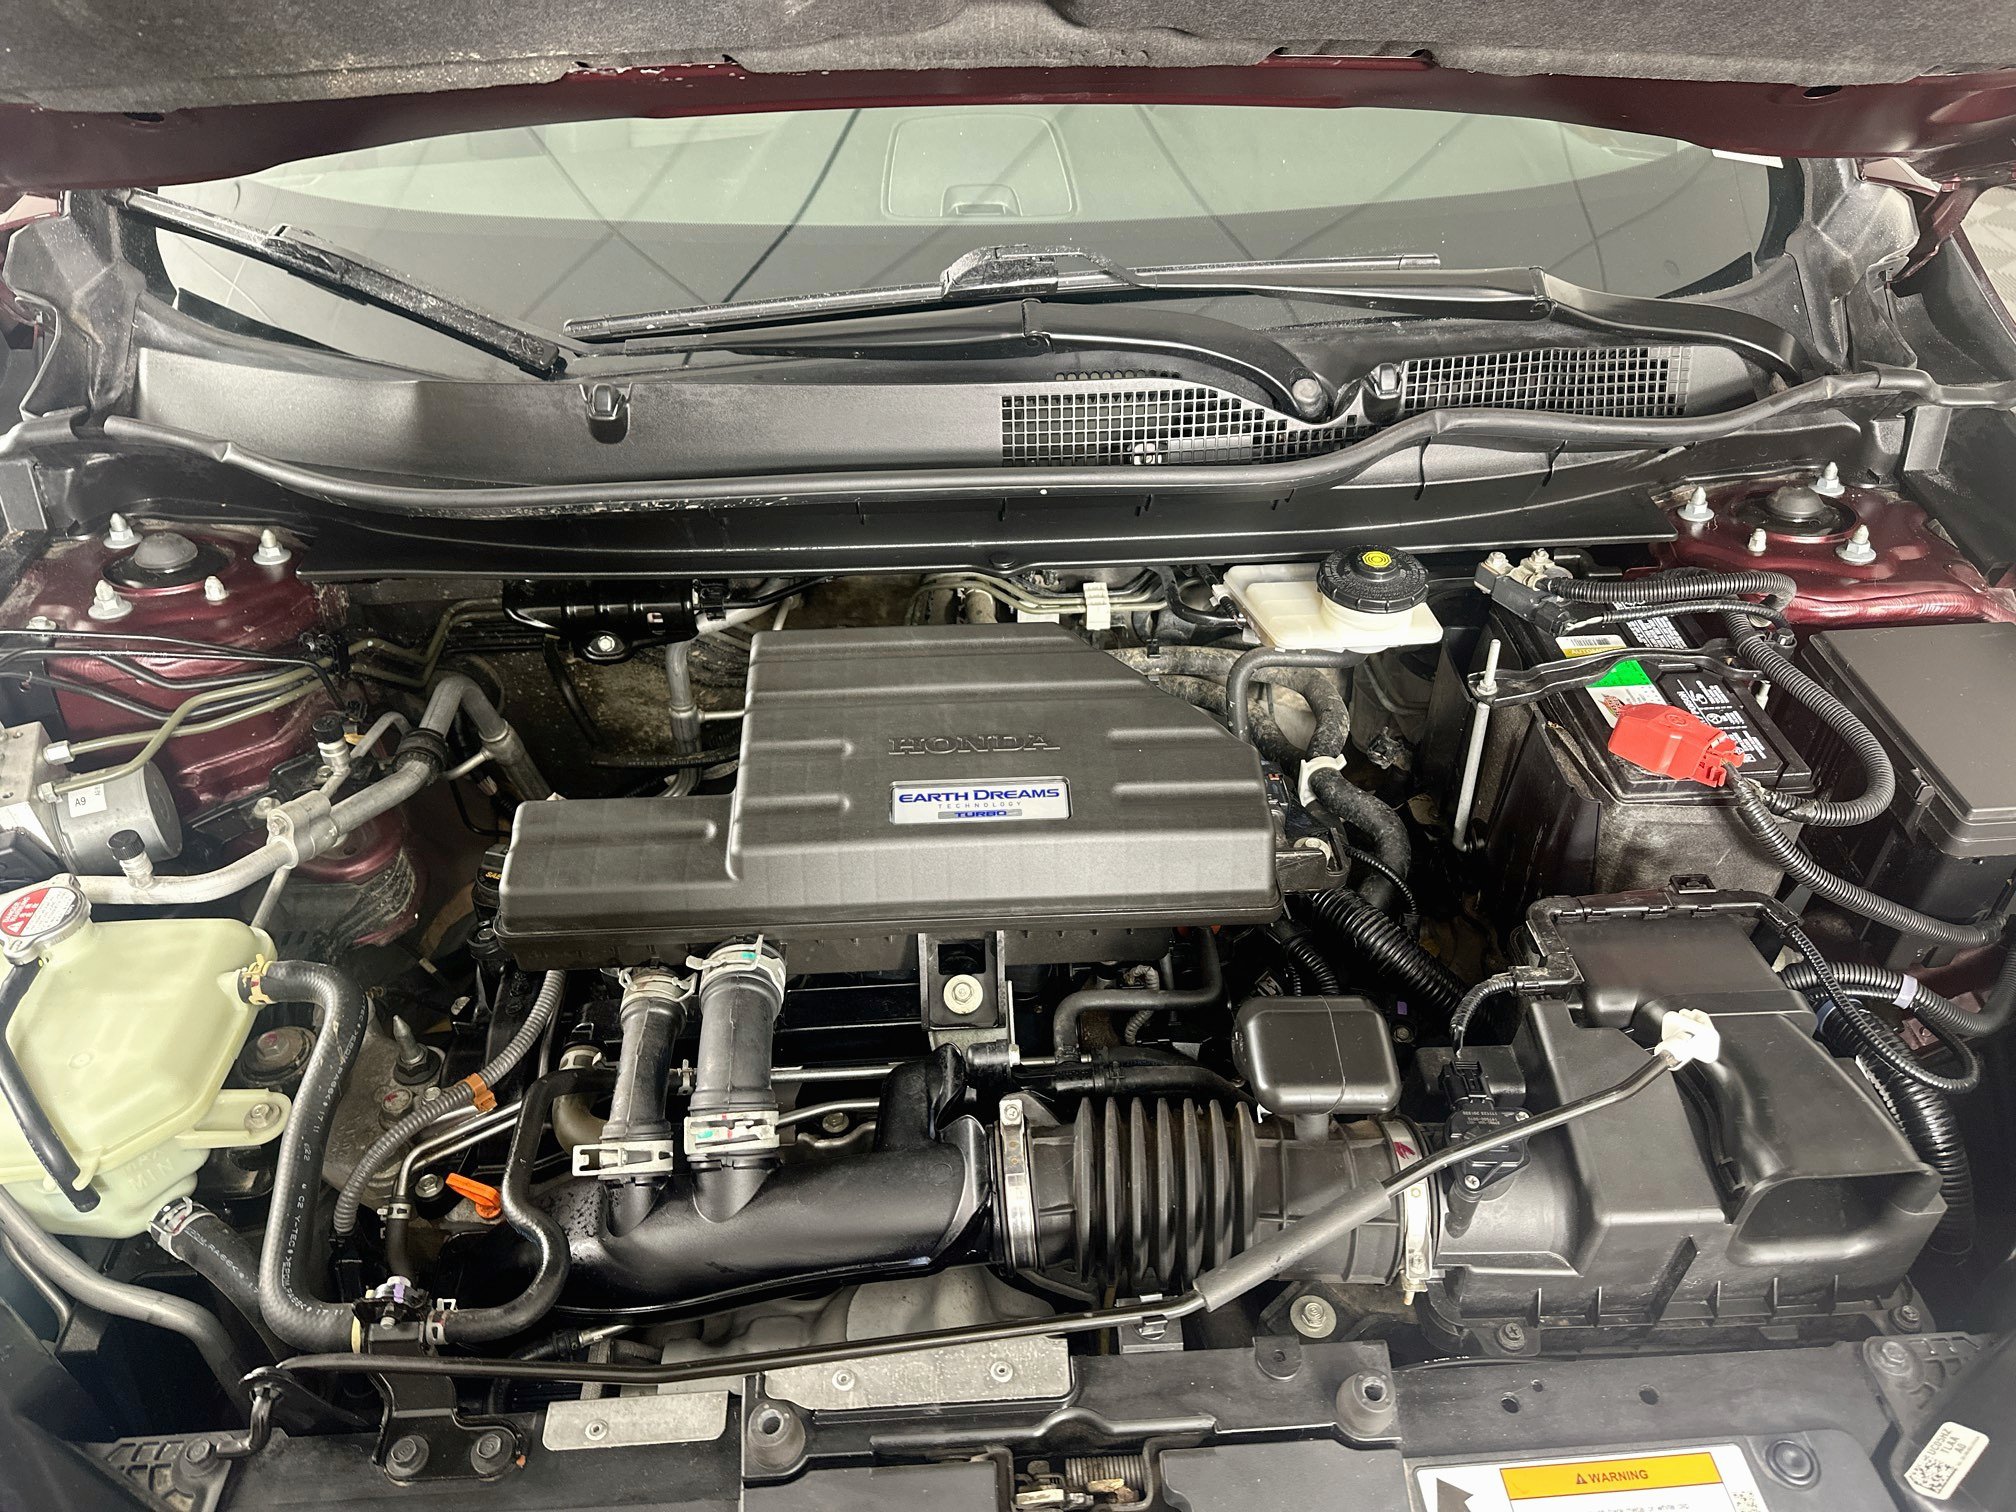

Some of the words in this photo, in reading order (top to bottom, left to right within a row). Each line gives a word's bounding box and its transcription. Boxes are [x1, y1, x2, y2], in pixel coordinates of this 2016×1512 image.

[889, 734, 1060, 755] HONDA
[75, 796, 87, 807] A9
[898, 792, 969, 803] EARTH
[973, 788, 1060, 801] DREAMS
[938, 801, 1022, 809] TECHNOLOGY
[954, 810, 1007, 818] TURBO
[1588, 1469, 1649, 1484] WARNING
